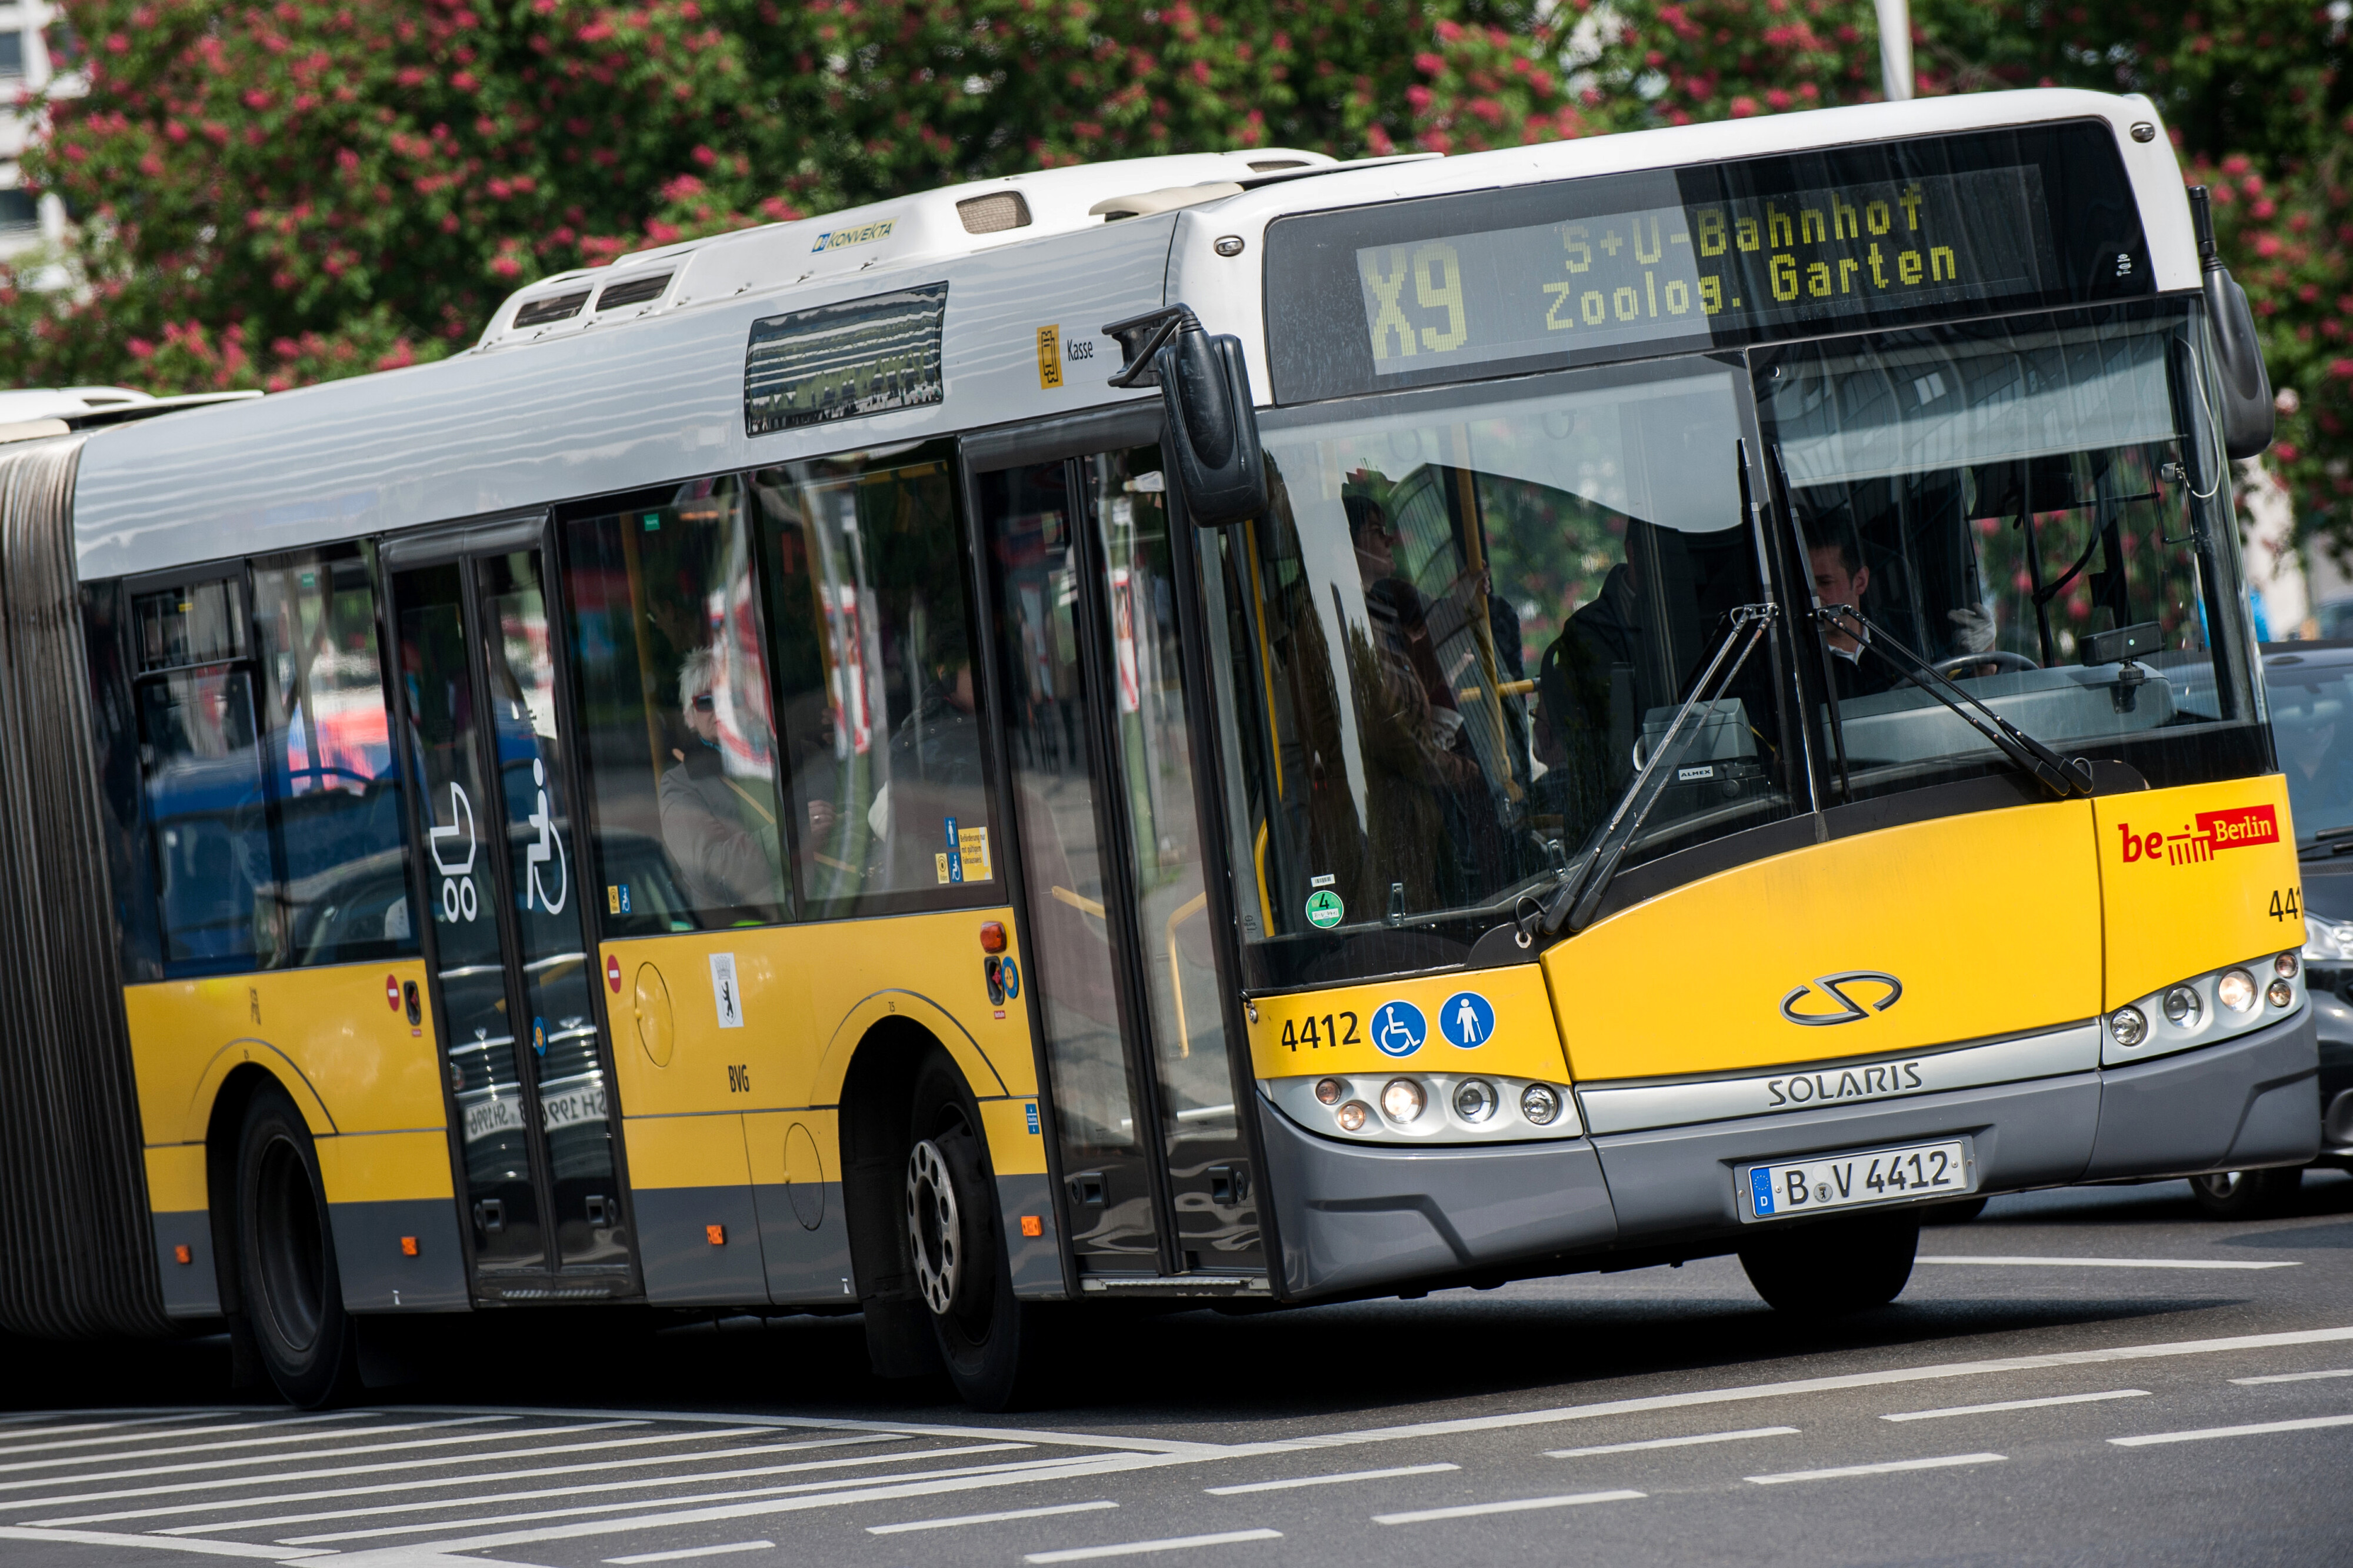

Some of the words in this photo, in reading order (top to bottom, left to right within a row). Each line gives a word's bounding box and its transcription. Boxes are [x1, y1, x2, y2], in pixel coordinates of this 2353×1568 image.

[826, 222, 892, 249] KONVEKTA
[1562, 183, 1922, 273] S+U-Bahnhof
[1357, 242, 1468, 359] X9
[1542, 271, 1741, 331] Zoolog.
[1769, 242, 1956, 301] Garten
[1067, 339, 1094, 361] Kasse
[1681, 769, 1711, 778] ALMEX
[2118, 823, 2162, 863] be
[2214, 816, 2272, 842] Berlin
[1318, 893, 1329, 909] 4
[1281, 1011, 1361, 1052] 4412
[728, 1064, 750, 1093] BVG
[1768, 1062, 1922, 1107] SOLARIS
[1785, 1169, 1809, 1205] B
[1832, 1162, 1852, 1197] V
[1866, 1150, 1951, 1193] 4412
[1761, 1196, 1768, 1206] D
